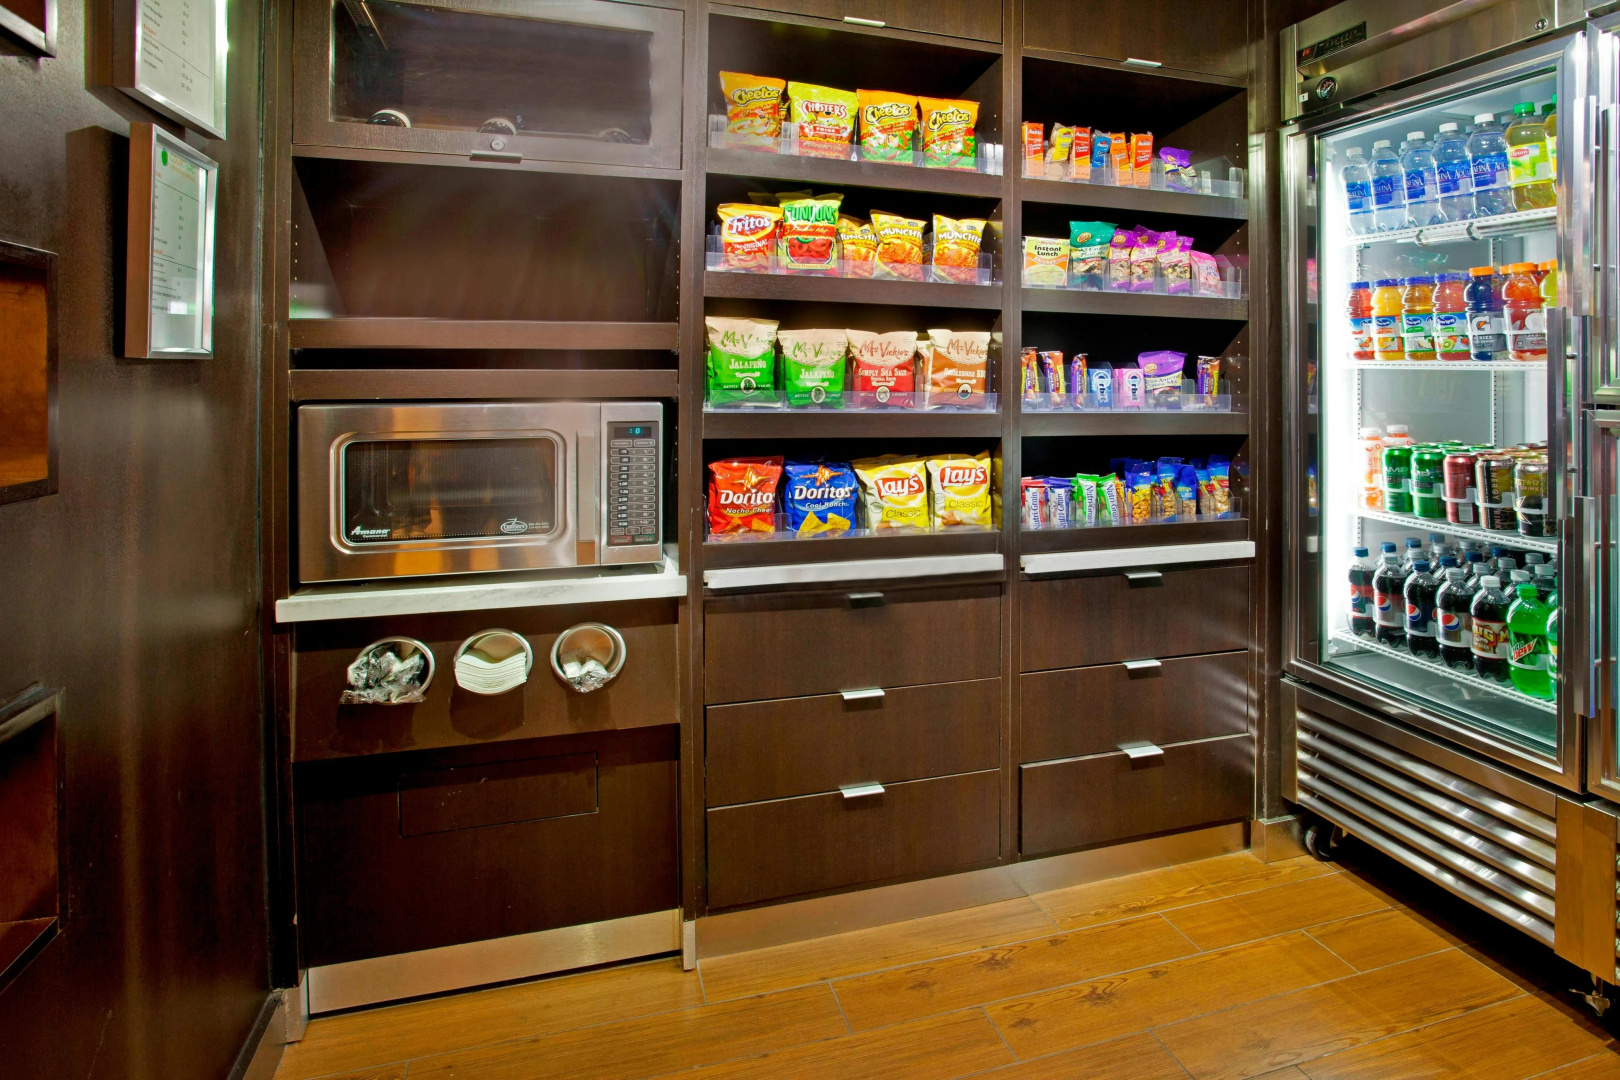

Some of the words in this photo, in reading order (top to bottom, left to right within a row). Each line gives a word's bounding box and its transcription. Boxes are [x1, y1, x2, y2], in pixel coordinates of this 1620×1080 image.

[733, 86, 780, 105] Cheetos
[866, 104, 911, 123] Cheetos
[929, 109, 970, 130] Cheetos
[728, 214, 771, 234] Fritos
[877, 476, 921, 497] Lay's
[943, 467, 985, 487] Lay's
[1490, 467, 1500, 501] ENERGY
[794, 485, 853, 500] Doritos
[885, 508, 922, 519] Classic
[948, 499, 984, 509] Classic
[351, 525, 390, 535] Amana
